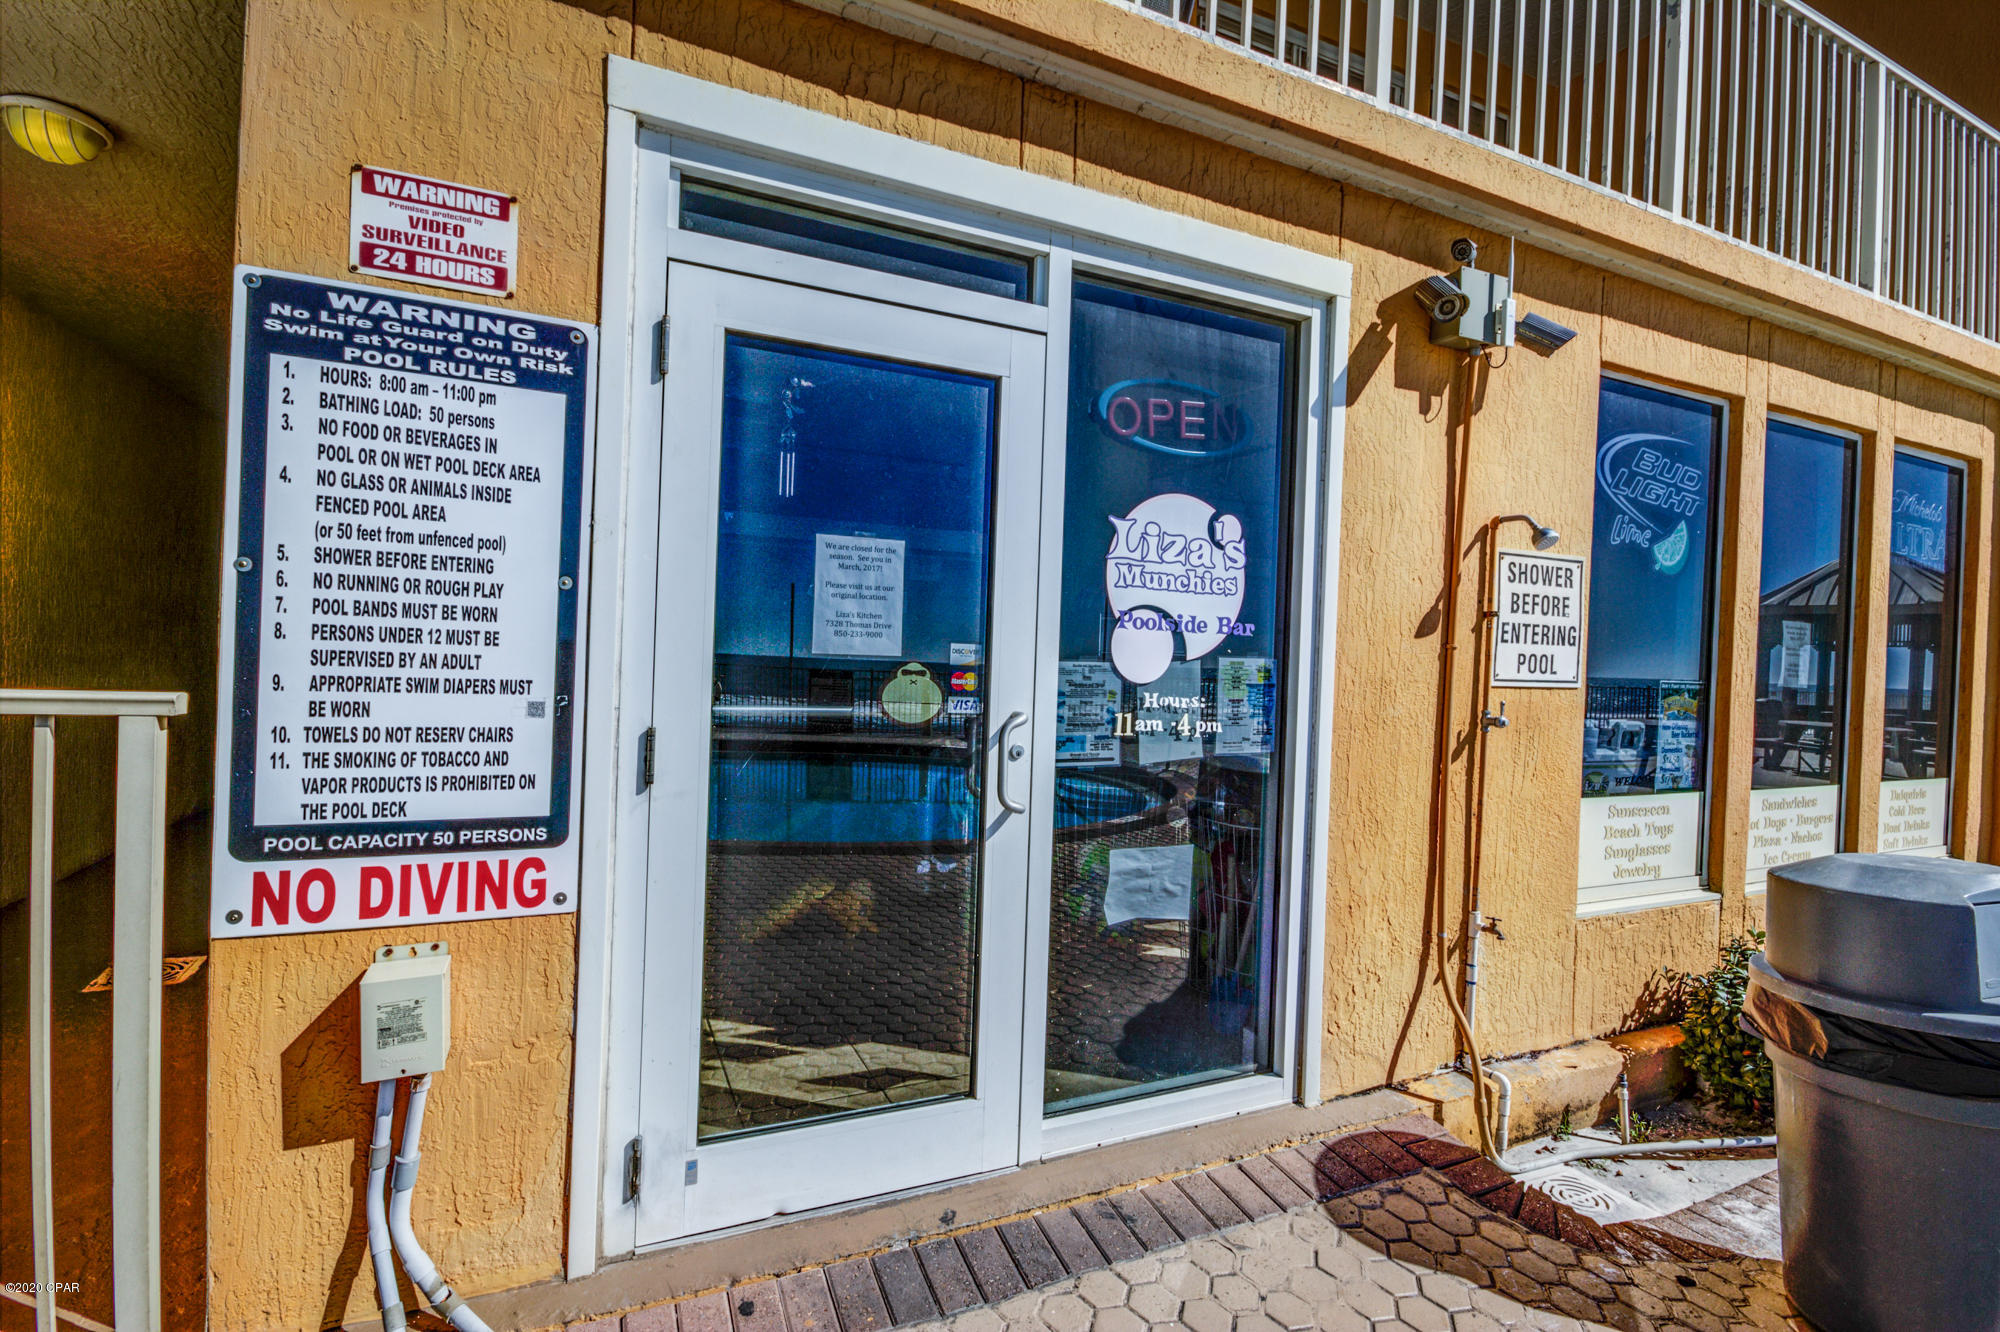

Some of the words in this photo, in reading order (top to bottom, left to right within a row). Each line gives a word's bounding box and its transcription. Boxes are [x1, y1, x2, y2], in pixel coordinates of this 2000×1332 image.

[373, 173, 501, 217] WARNING
[388, 201, 430, 216] Premises
[432, 209, 472, 224] protected
[474, 216, 484, 227] by
[408, 215, 465, 240] VIDEO
[361, 223, 508, 264] SURVEILLANCE
[372, 248, 408, 271] 24
[415, 256, 496, 287] HOURS
[327, 291, 536, 339] WARNING
[270, 302, 310, 319] No
[320, 310, 373, 328] Life
[381, 320, 463, 343] Guard
[471, 337, 502, 349] on
[511, 340, 568, 359] Duty
[263, 318, 343, 340] Swim
[352, 335, 381, 347] at
[382, 335, 446, 356] Your
[453, 346, 511, 365] Own
[519, 356, 573, 375] Risk
[343, 346, 420, 370] POOL
[429, 358, 516, 383] RULES
[283, 360, 295, 379] 1.
[319, 365, 371, 388] HOURS:
[379, 373, 406, 393] 8:00
[409, 382, 428, 396] am
[442, 382, 475, 402] 11:00
[478, 391, 496, 407] pm
[281, 386, 293, 405] 2.
[319, 391, 379, 415] BATHING
[383, 399, 421, 420] LOAD:
[429, 405, 444, 423] 50
[447, 412, 495, 429] persons
[1108, 397, 1238, 442] OPEN
[281, 412, 293, 431] 3.
[318, 417, 338, 436] NO
[342, 419, 378, 440] FOOD
[382, 424, 401, 443] OR
[405, 427, 480, 452] BEVERAGES
[484, 436, 497, 454] IN
[317, 442, 353, 463] POOL
[357, 447, 376, 465] OR
[380, 449, 399, 468] ON
[403, 452, 431, 471] WET
[435, 455, 468, 475] POOL
[472, 460, 505, 479] DECK
[508, 464, 540, 483] AREA
[1632, 446, 1702, 491] BUD
[279, 465, 291, 483] 4.
[316, 468, 336, 487] NO
[340, 471, 384, 491] GLASS
[388, 475, 406, 494] OR
[410, 478, 467, 499] ANIMALS
[471, 484, 511, 503] INSIDE
[1611, 468, 1704, 517] LIGHT
[315, 494, 369, 515] FENCED
[373, 499, 408, 519] POOL
[411, 503, 446, 522] AREA
[314, 520, 333, 542] (or
[336, 522, 352, 539] 50
[356, 523, 381, 542] feet
[385, 525, 414, 544] from
[418, 529, 473, 548] unfenced
[477, 535, 506, 555] pool)
[1105, 515, 1247, 571] Liza's
[1611, 514, 1652, 548] Lime
[824, 541, 837, 550] We
[851, 543, 872, 552] closed
[874, 545, 885, 553] for
[886, 546, 897, 554] the
[828, 553, 854, 561] season.
[857, 554, 870, 562] See
[885, 556, 891, 564] in
[838, 562, 862, 572] March,
[863, 564, 883, 572] 2017!
[1114, 563, 1238, 596] Munchies
[1507, 561, 1573, 589] SHOWER
[824, 580, 847, 589] Please
[848, 582, 863, 590] visit
[830, 592, 857, 601] original
[858, 592, 888, 601] location.
[835, 609, 854, 619] Liza's
[856, 611, 883, 620] Kitchen
[1510, 592, 1570, 618] BEFORE
[825, 619, 844, 628] 7328
[845, 620, 872, 629] Thomas
[873, 621, 892, 630] Drive
[833, 629, 884, 639] 850-233-9000
[1117, 609, 1208, 634] Poolside
[1216, 616, 1256, 637] Bar
[1500, 621, 1577, 647] ENTERING
[1516, 653, 1558, 675] POOL
[953, 699, 977, 711] VISA
[1143, 692, 1206, 710] Hours:
[1194, 720, 1224, 738] pm
[269, 751, 289, 769] 11.
[302, 751, 329, 768] THE
[333, 751, 396, 768] SMOKING
[400, 751, 417, 767] OF
[420, 750, 480, 767] TOBACCO
[483, 750, 508, 766] AND
[301, 776, 347, 794] VAPOR
[351, 775, 421, 793] PRODUCTS
[425, 775, 437, 792] IS
[441, 774, 515, 791] PROHIBITED
[518, 773, 535, 789] ON
[300, 802, 327, 820] THE
[331, 801, 367, 819] POOL
[371, 800, 407, 818] DECK
[1607, 803, 1670, 819] Sunscreen
[1761, 796, 1818, 812] Sandwiches
[1888, 806, 1905, 817] Cold
[1908, 805, 1926, 816] Beer
[1603, 823, 1640, 840] Beach
[1644, 821, 1674, 839] Toys
[1750, 818, 1760, 830] ot
[1763, 815, 1787, 832] Dogs
[1796, 813, 1834, 828] Burgers
[1904, 820, 1930, 832] Drinks
[263, 836, 323, 852] POOL
[328, 832, 428, 849] CAPACITY
[432, 831, 454, 845] 50
[459, 826, 547, 844] PERSONS
[1753, 835, 1781, 848] Pizza
[1791, 830, 1823, 844] Nachos
[1883, 837, 1899, 849] Soft
[1902, 835, 1928, 848] Drinks
[1604, 843, 1672, 863] Sunglasses
[1763, 852, 1778, 865] Ice
[1613, 862, 1662, 880] Jewelry
[251, 867, 335, 926] NO
[358, 856, 546, 920] DIVING
